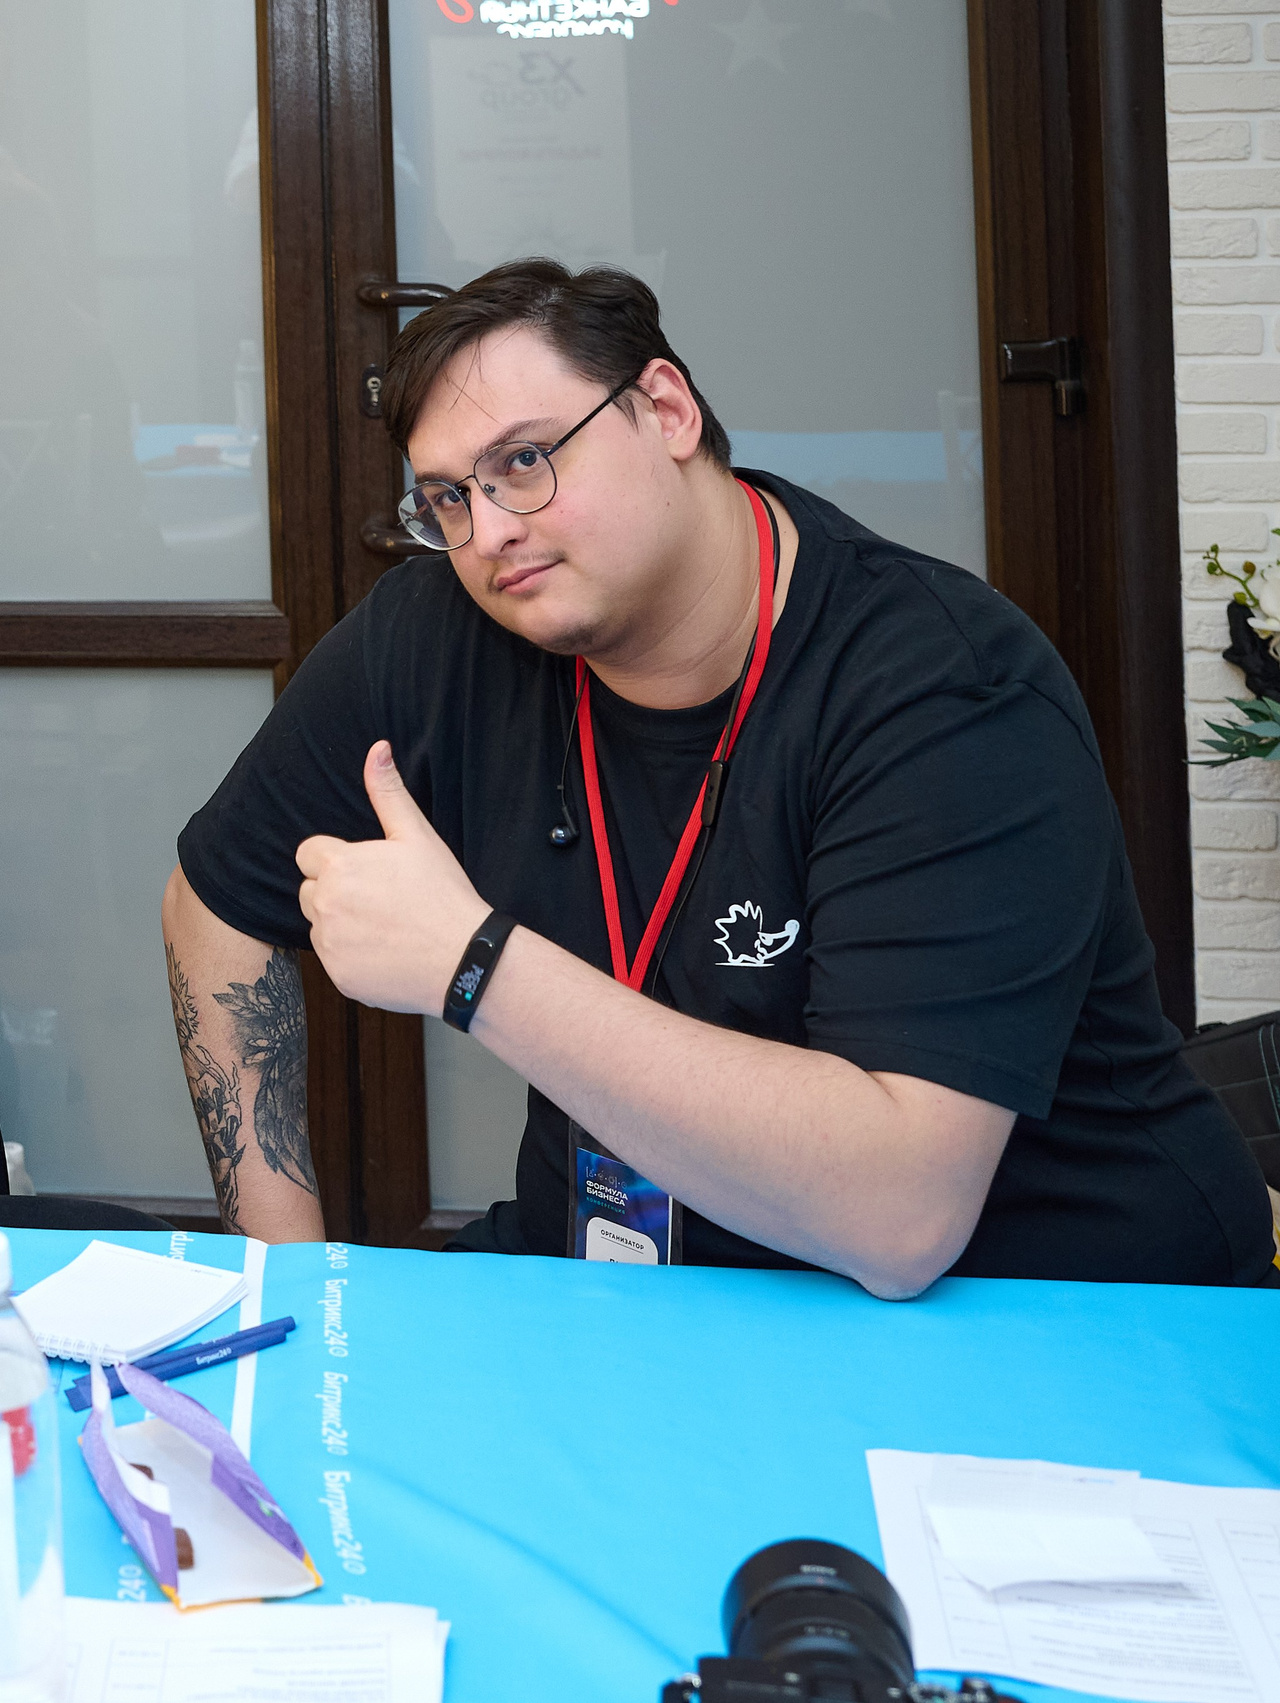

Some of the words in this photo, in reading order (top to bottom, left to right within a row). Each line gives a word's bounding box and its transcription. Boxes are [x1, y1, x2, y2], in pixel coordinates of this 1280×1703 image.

[586, 1180, 628, 1200] ФОРМУЛА
[586, 1187, 625, 1206] БИЗНЕСА
[600, 1229, 644, 1251] ОРГАНИЗАТОР
